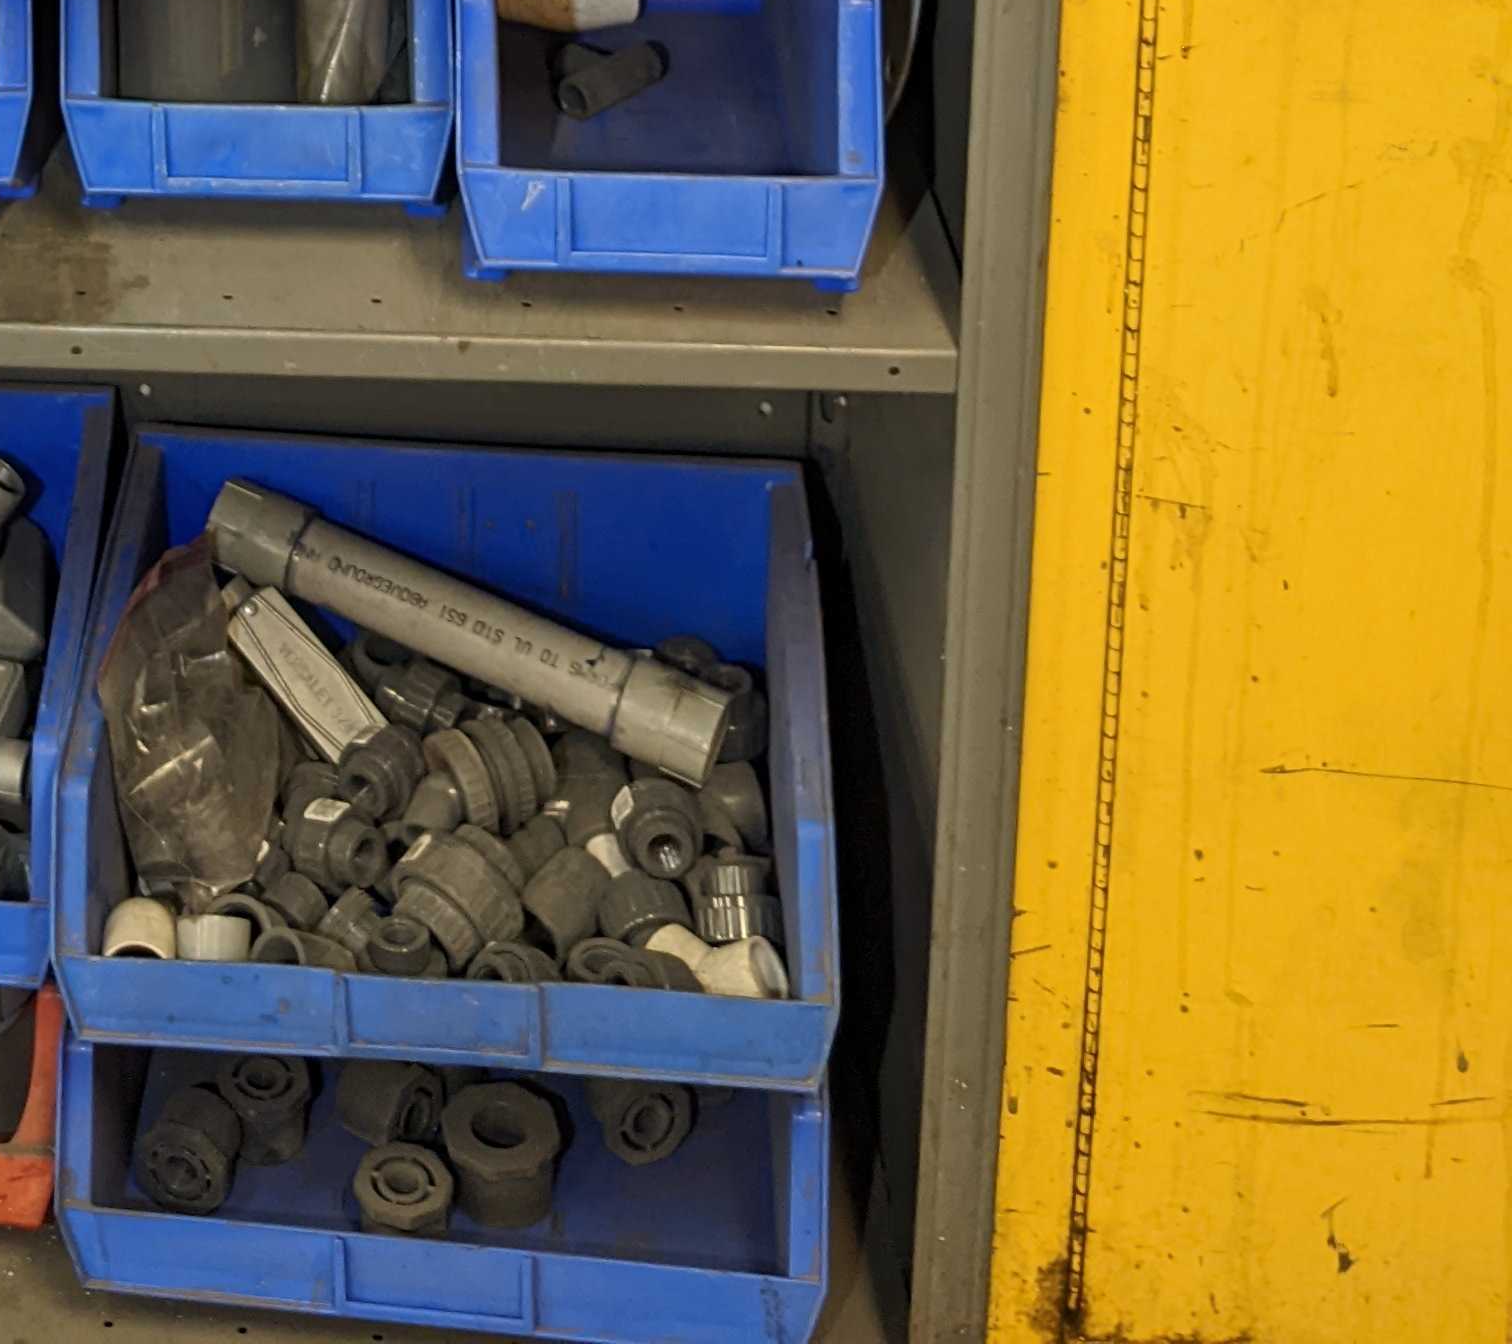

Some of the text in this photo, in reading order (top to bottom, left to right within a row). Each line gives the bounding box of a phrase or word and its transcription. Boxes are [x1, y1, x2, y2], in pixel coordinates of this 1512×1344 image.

[439, 604, 469, 627] 651
[474, 620, 505, 644] STD
[514, 636, 533, 655] UL
[540, 648, 559, 669] TO
